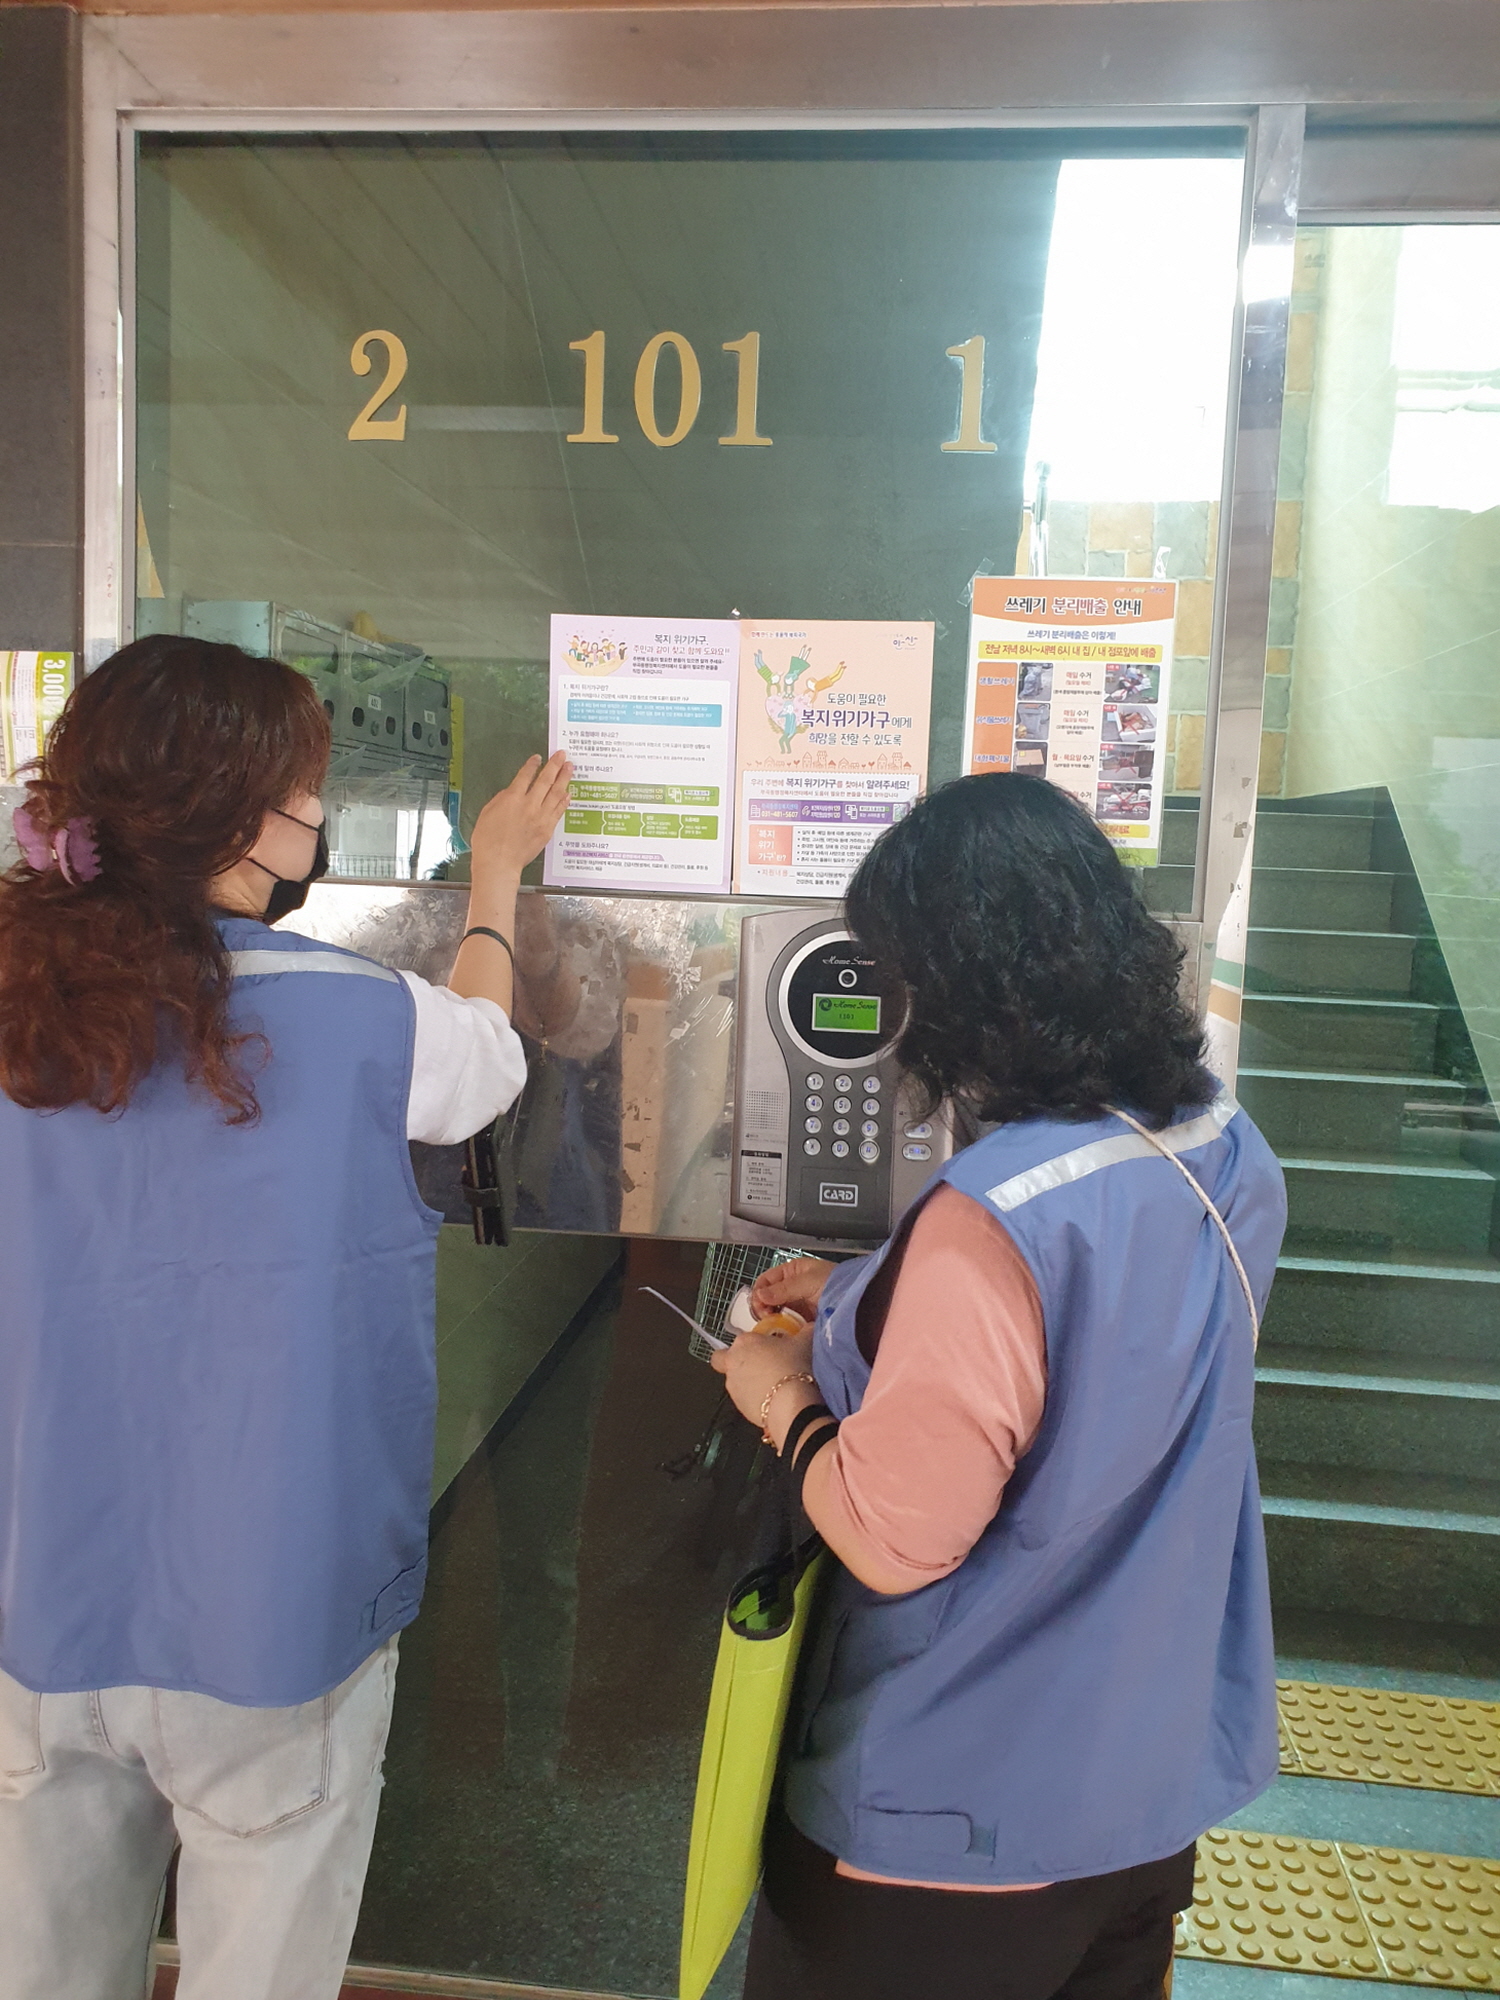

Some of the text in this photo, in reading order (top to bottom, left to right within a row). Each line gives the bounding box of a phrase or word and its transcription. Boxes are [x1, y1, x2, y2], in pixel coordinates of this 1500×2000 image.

[348, 329, 997, 453] 2 101 1
[1006, 598, 1141, 615] 쓰레기 분리배출 안내
[654, 634, 671, 644] 복지
[1027, 630, 1116, 639] 쓰레기 분리배출은 이렇게!
[633, 645, 653, 654] 주민과
[1003, 645, 1017, 654] 저녁
[1058, 646, 1070, 655] 6시
[1073, 646, 1080, 656] 내
[1083, 646, 1090, 656] 집
[1098, 646, 1106, 656] 내
[1108, 647, 1138, 657] 점포앞에
[1141, 648, 1156, 658] 배출
[828, 693, 886, 706] 도움이 필요한
[809, 733, 902, 746] 희망을 전할 수 있도록
[786, 778, 802, 787] 복지
[804, 778, 843, 788] 위기가구를
[866, 780, 909, 790] 알려주세요!
[758, 840, 774, 849] 위기
[822, 956, 876, 966] Home Sense
[824, 1189, 853, 1200] CARD
